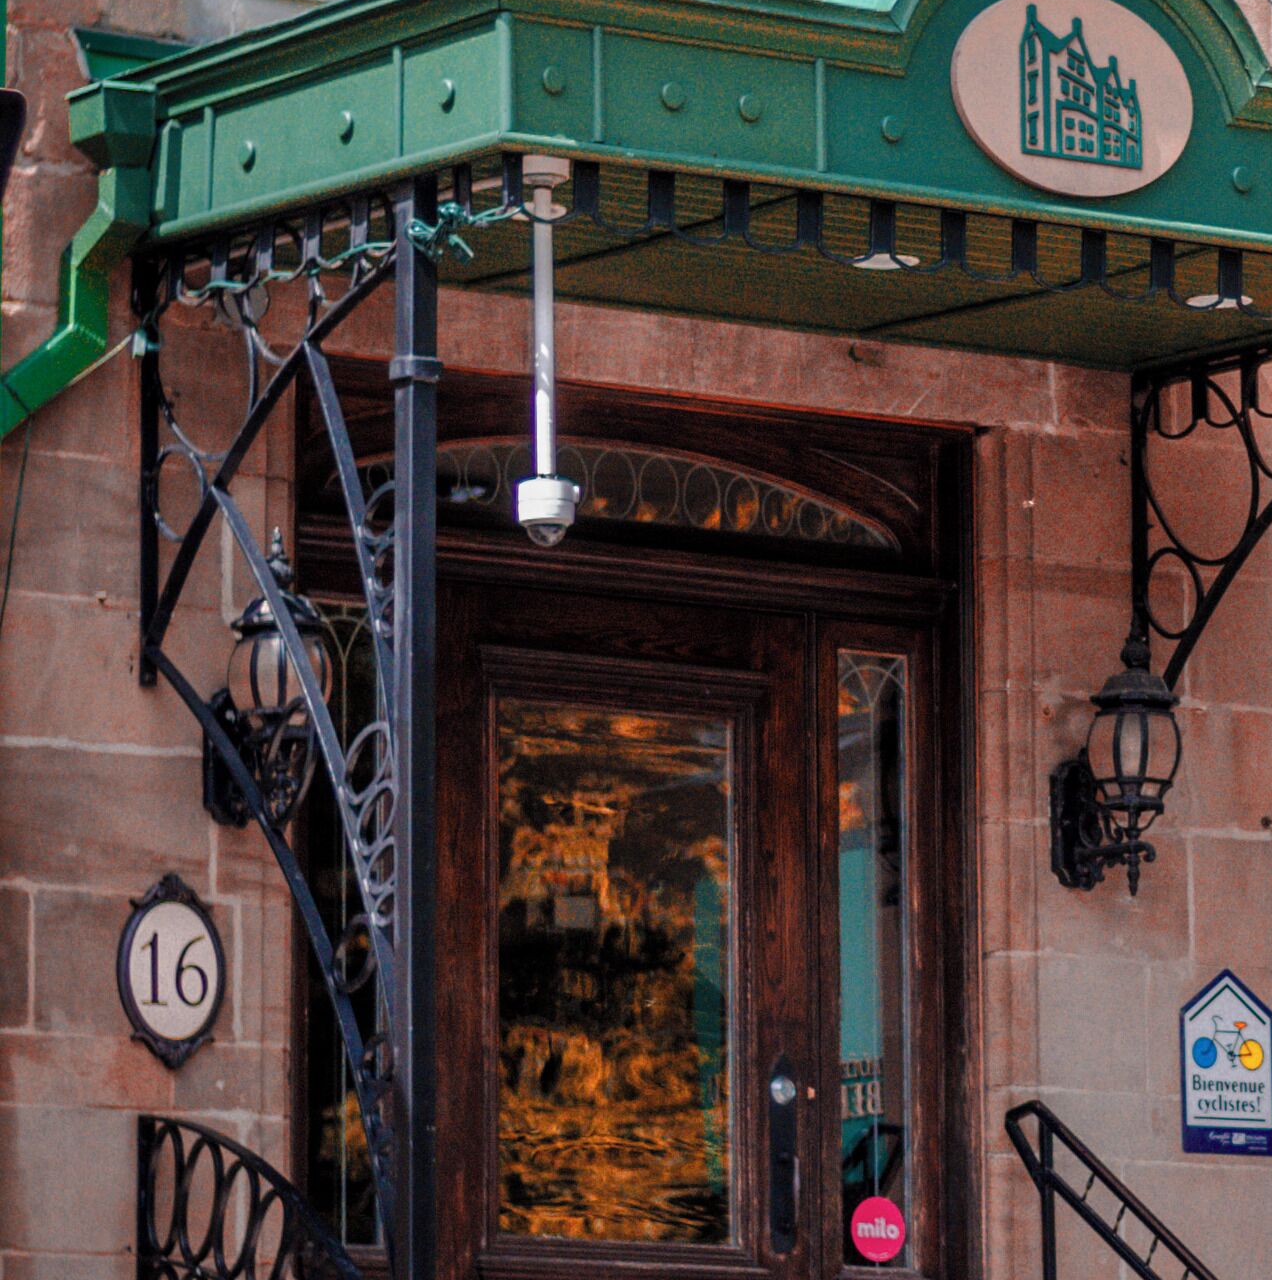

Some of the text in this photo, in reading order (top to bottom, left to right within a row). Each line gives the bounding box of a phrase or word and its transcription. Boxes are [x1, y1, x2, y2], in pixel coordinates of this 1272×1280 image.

[141, 930, 208, 1007] 16
[1192, 1073, 1266, 1094] Bienvenue
[1198, 1094, 1262, 1114] cyclistes!
[857, 1216, 899, 1240] milo
